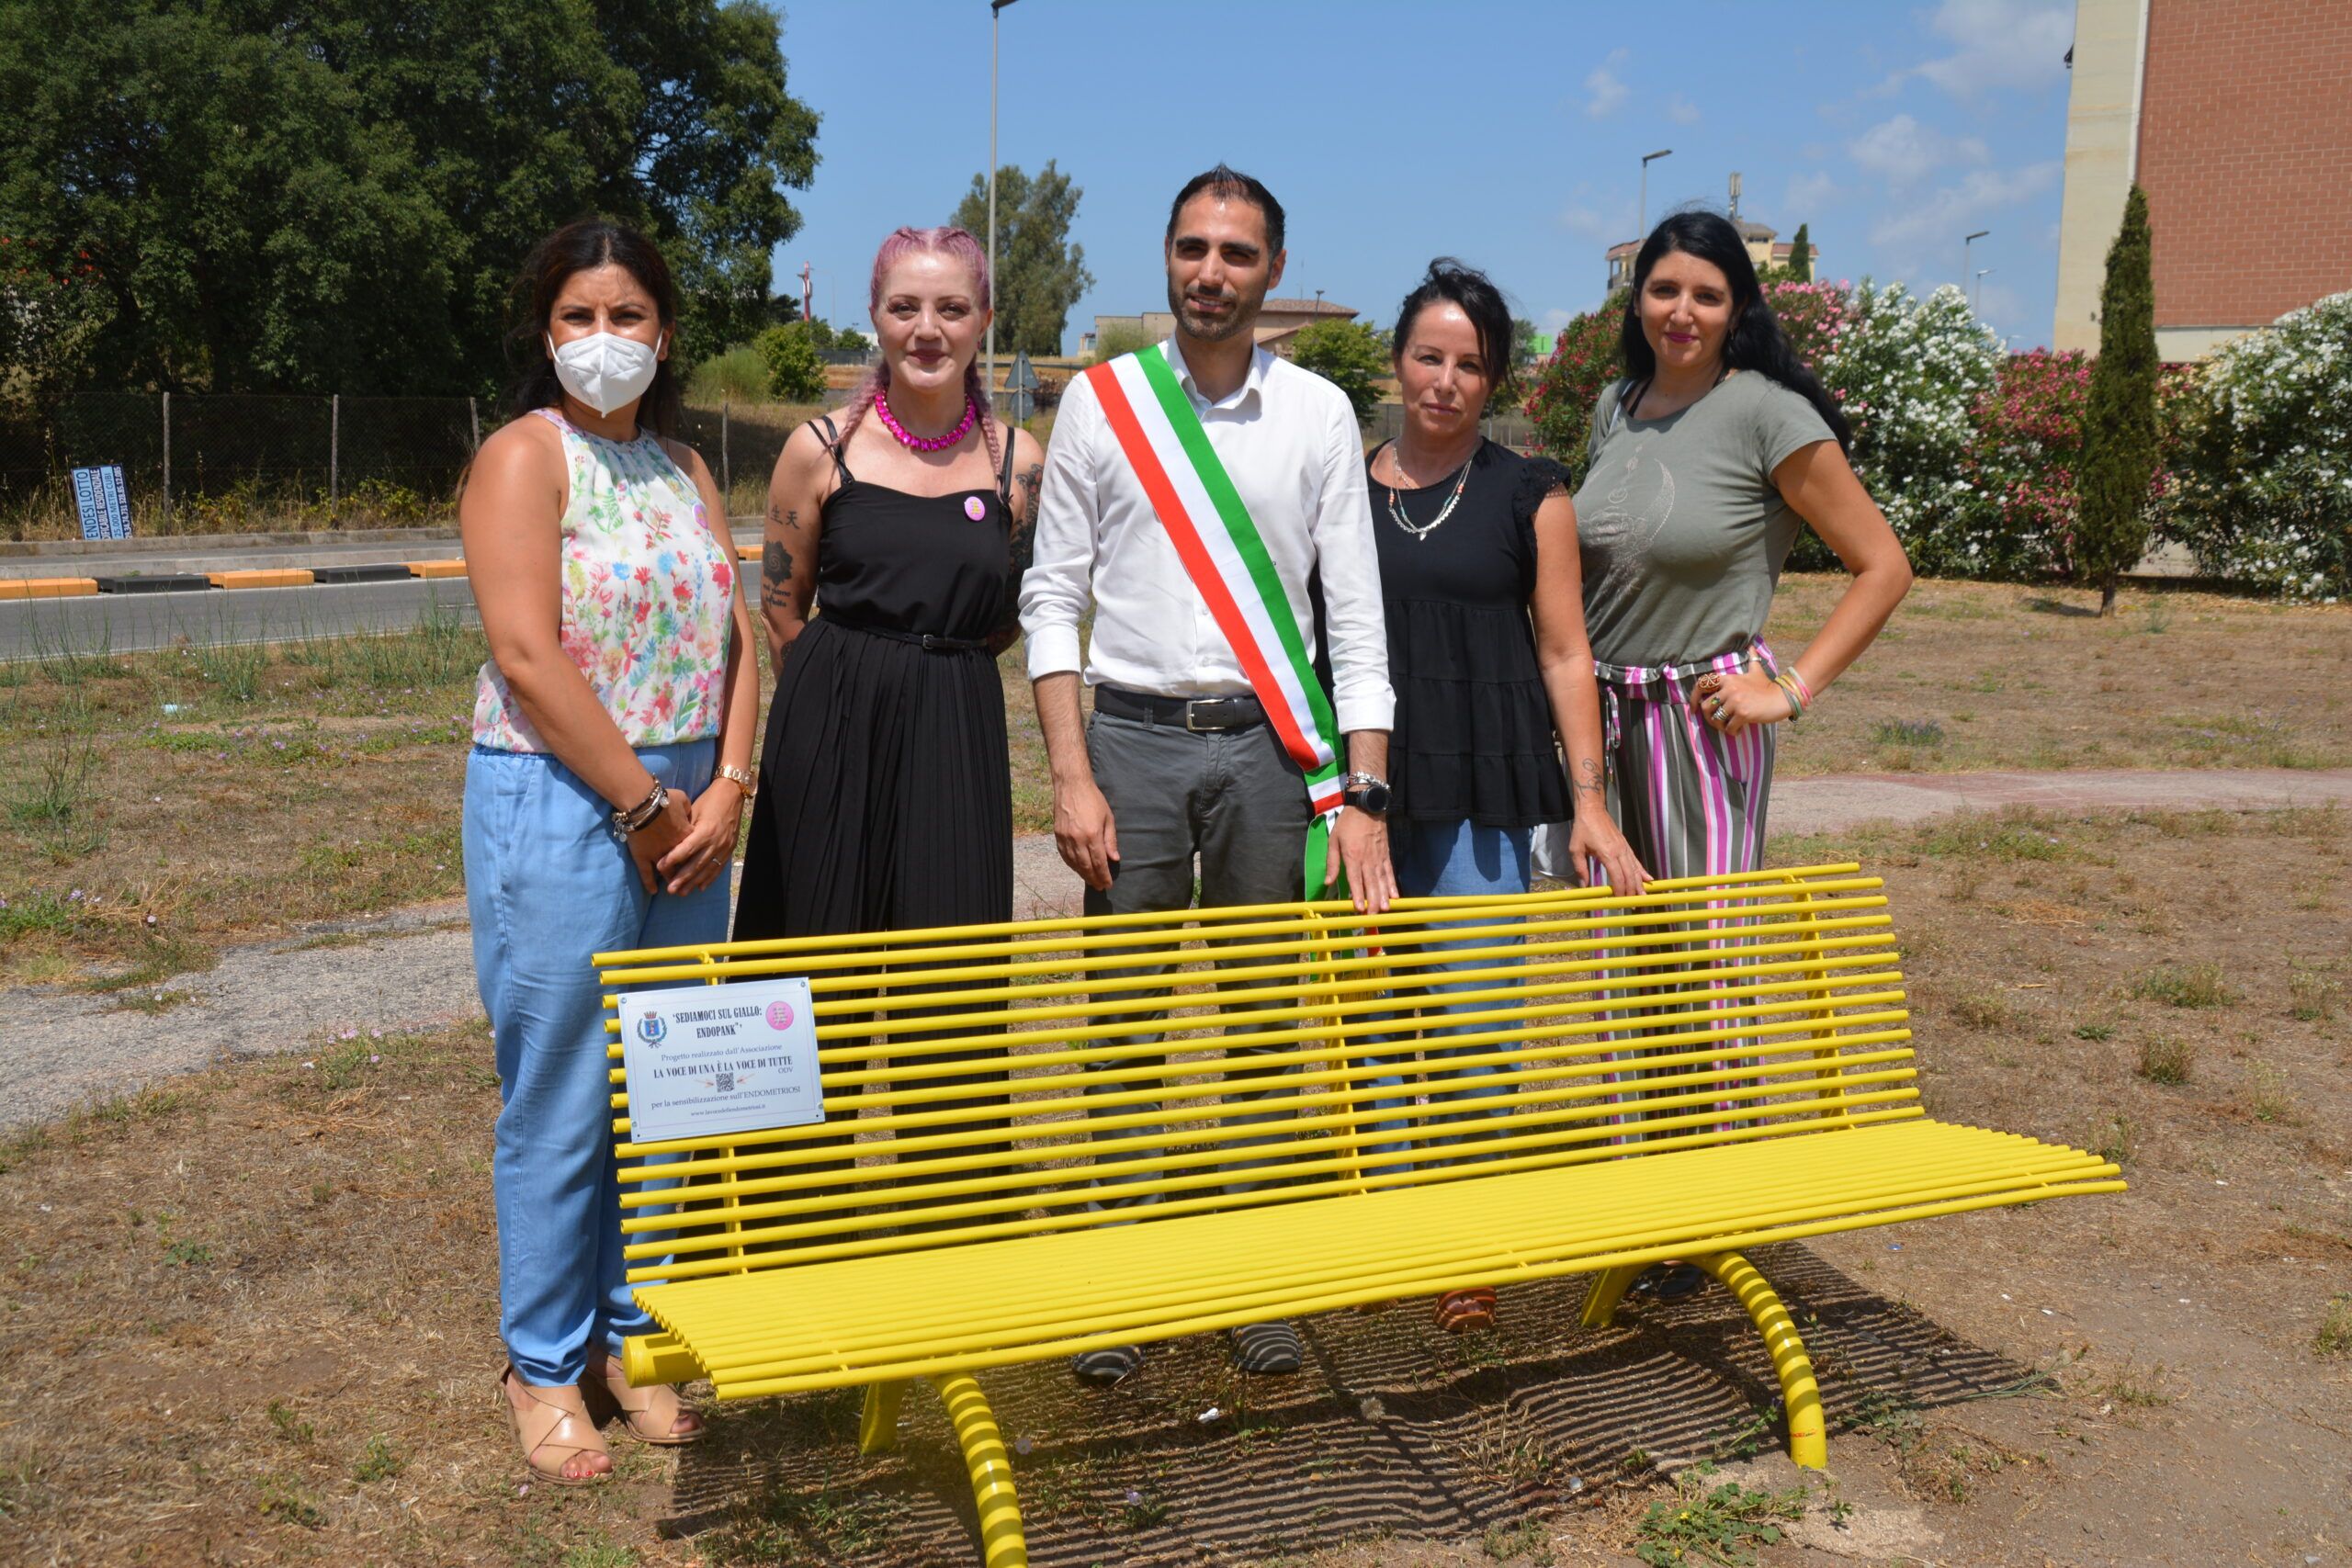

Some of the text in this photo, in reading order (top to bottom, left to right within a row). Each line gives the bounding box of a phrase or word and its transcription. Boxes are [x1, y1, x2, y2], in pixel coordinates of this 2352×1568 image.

[104, 472, 113, 489] CUBI
[75, 471, 98, 540] ENDESI LOTTO
[90, 468, 110, 539] DIFICABILE RESIDENZIALE
[107, 491, 117, 513] METRI
[718, 1009, 731, 1020] SUL
[733, 1006, 762, 1018] GIALLO:
[662, 1044, 783, 1062] Progetto realizzato dall'Associazione
[654, 1056, 793, 1078] LA VOCE DI UNA È LA VOCE DI TUTTE
[651, 1101, 662, 1110] per
[672, 1095, 728, 1106] sensibilizzazione
